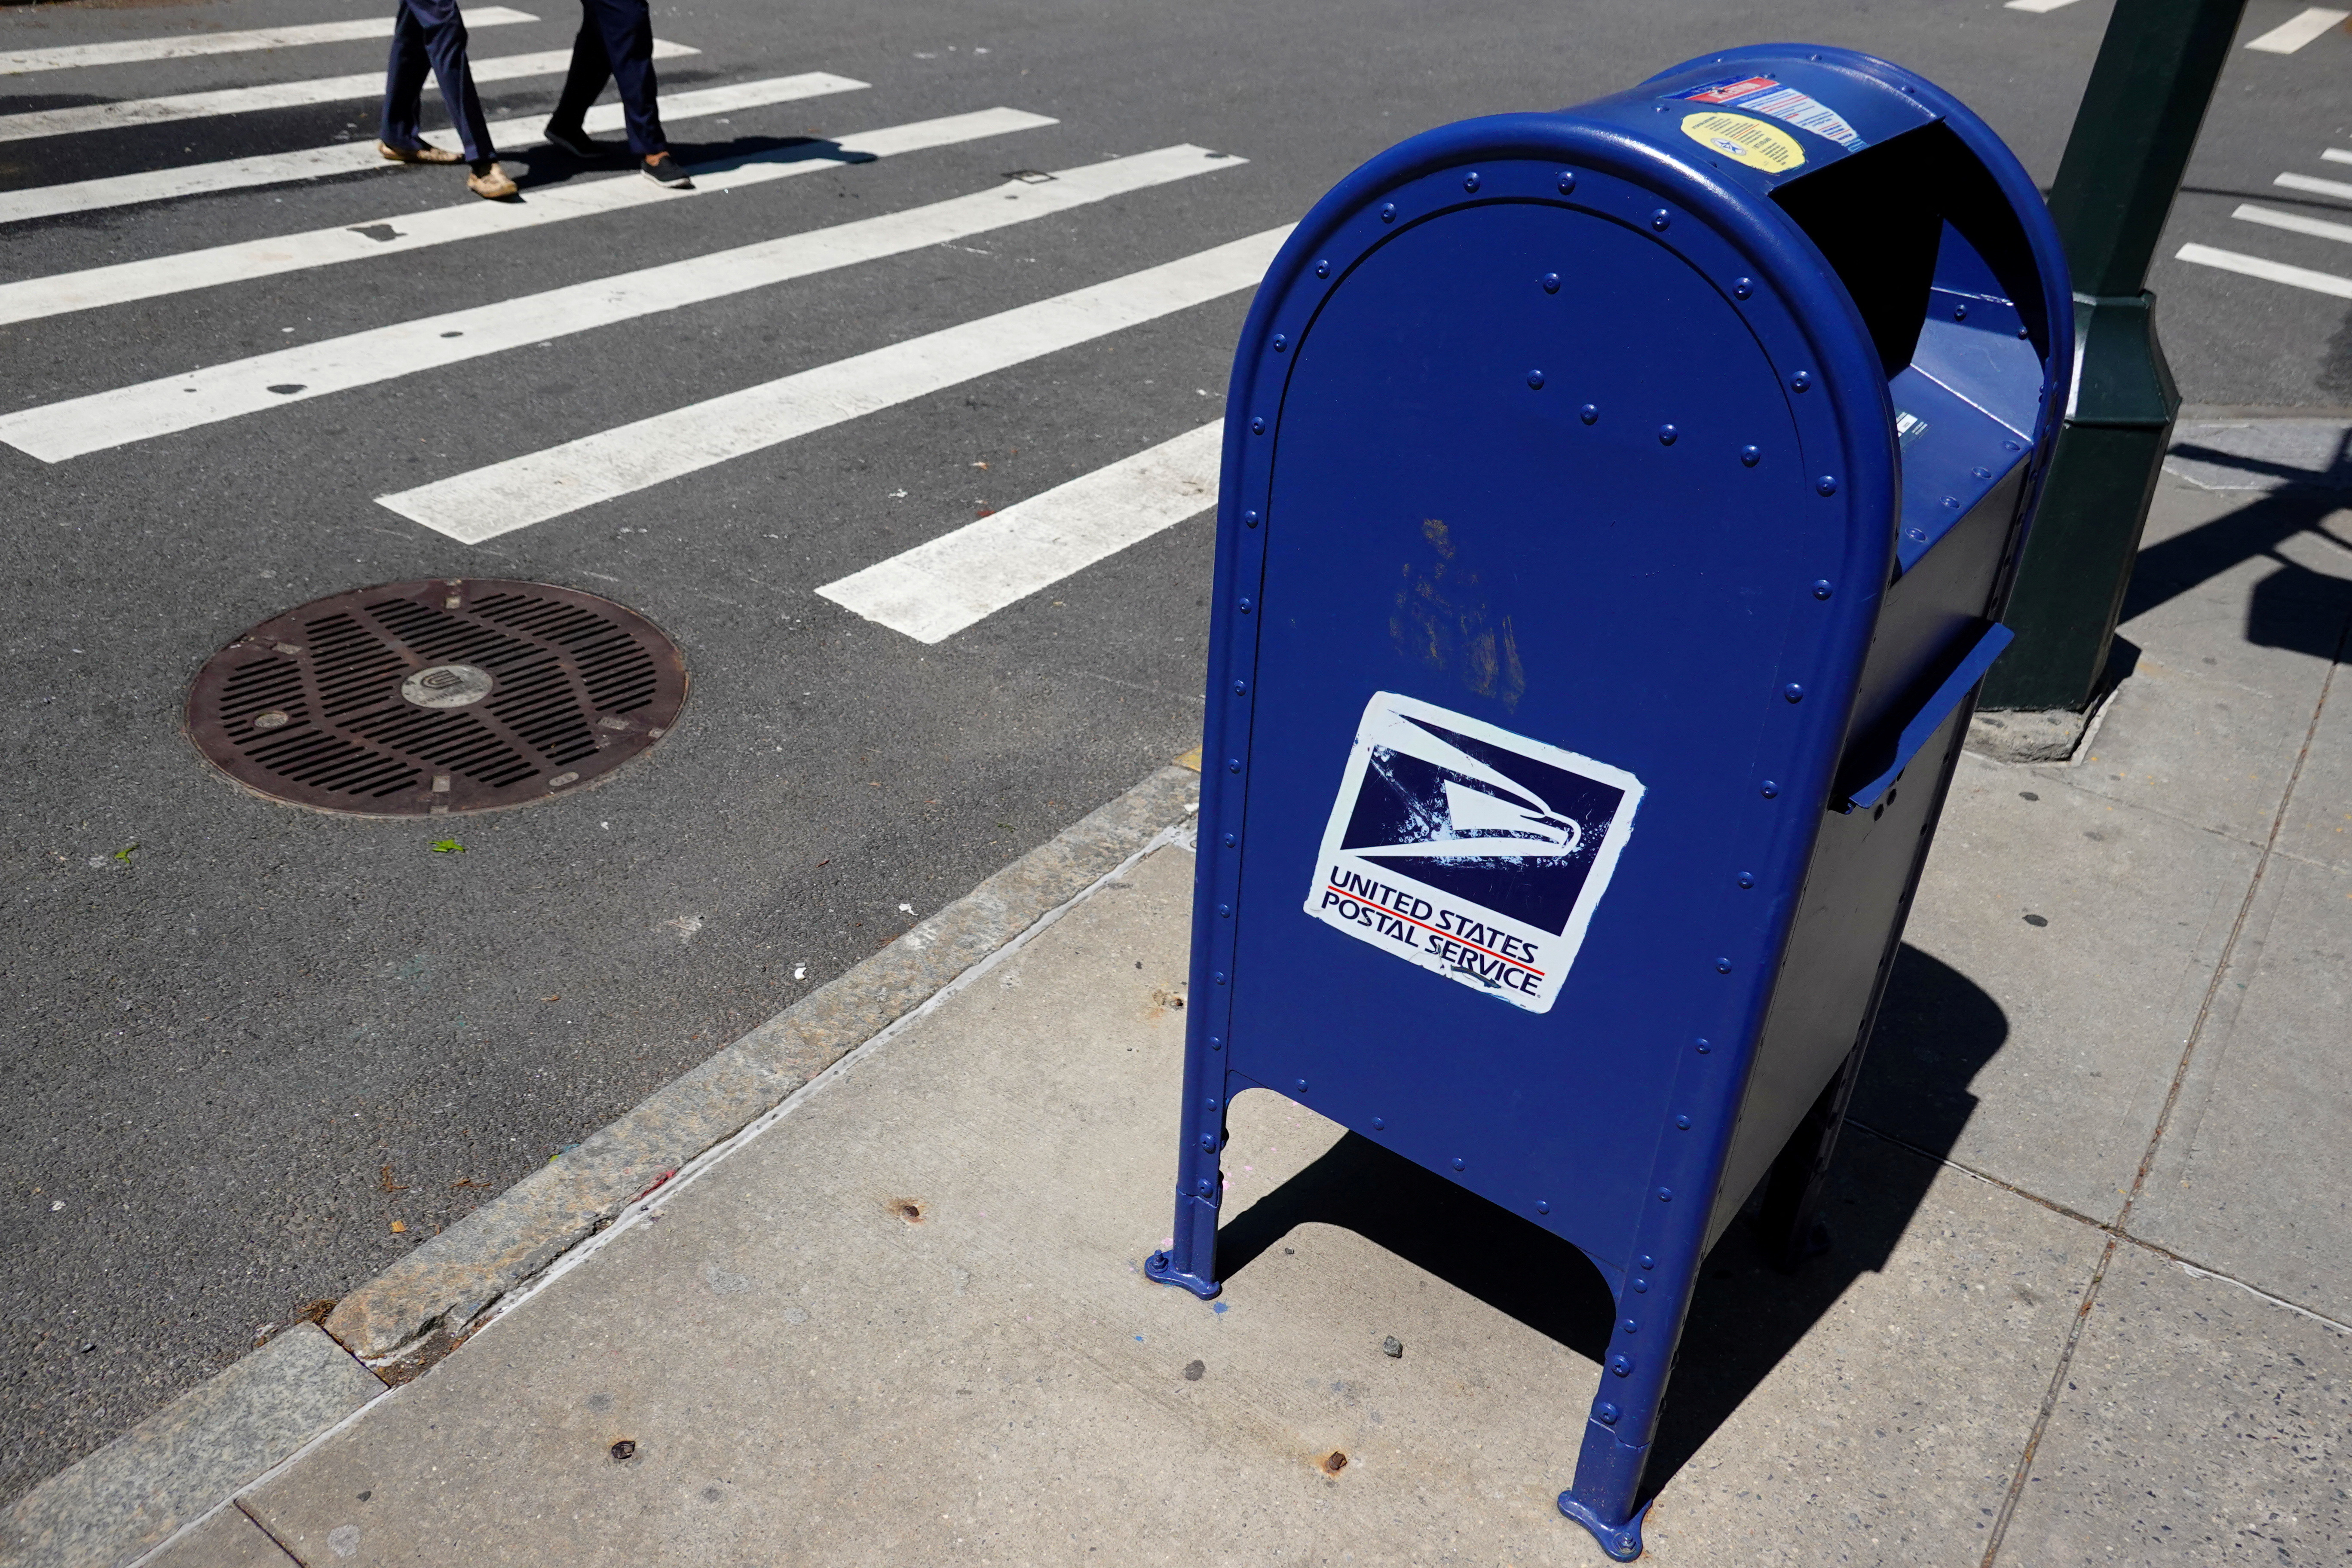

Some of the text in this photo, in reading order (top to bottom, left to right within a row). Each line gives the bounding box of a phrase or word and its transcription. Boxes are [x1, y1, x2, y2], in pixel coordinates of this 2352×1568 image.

[1321, 891, 1543, 996] POSTAL SERVICE
[1330, 865, 1539, 963] UNITED STATES
